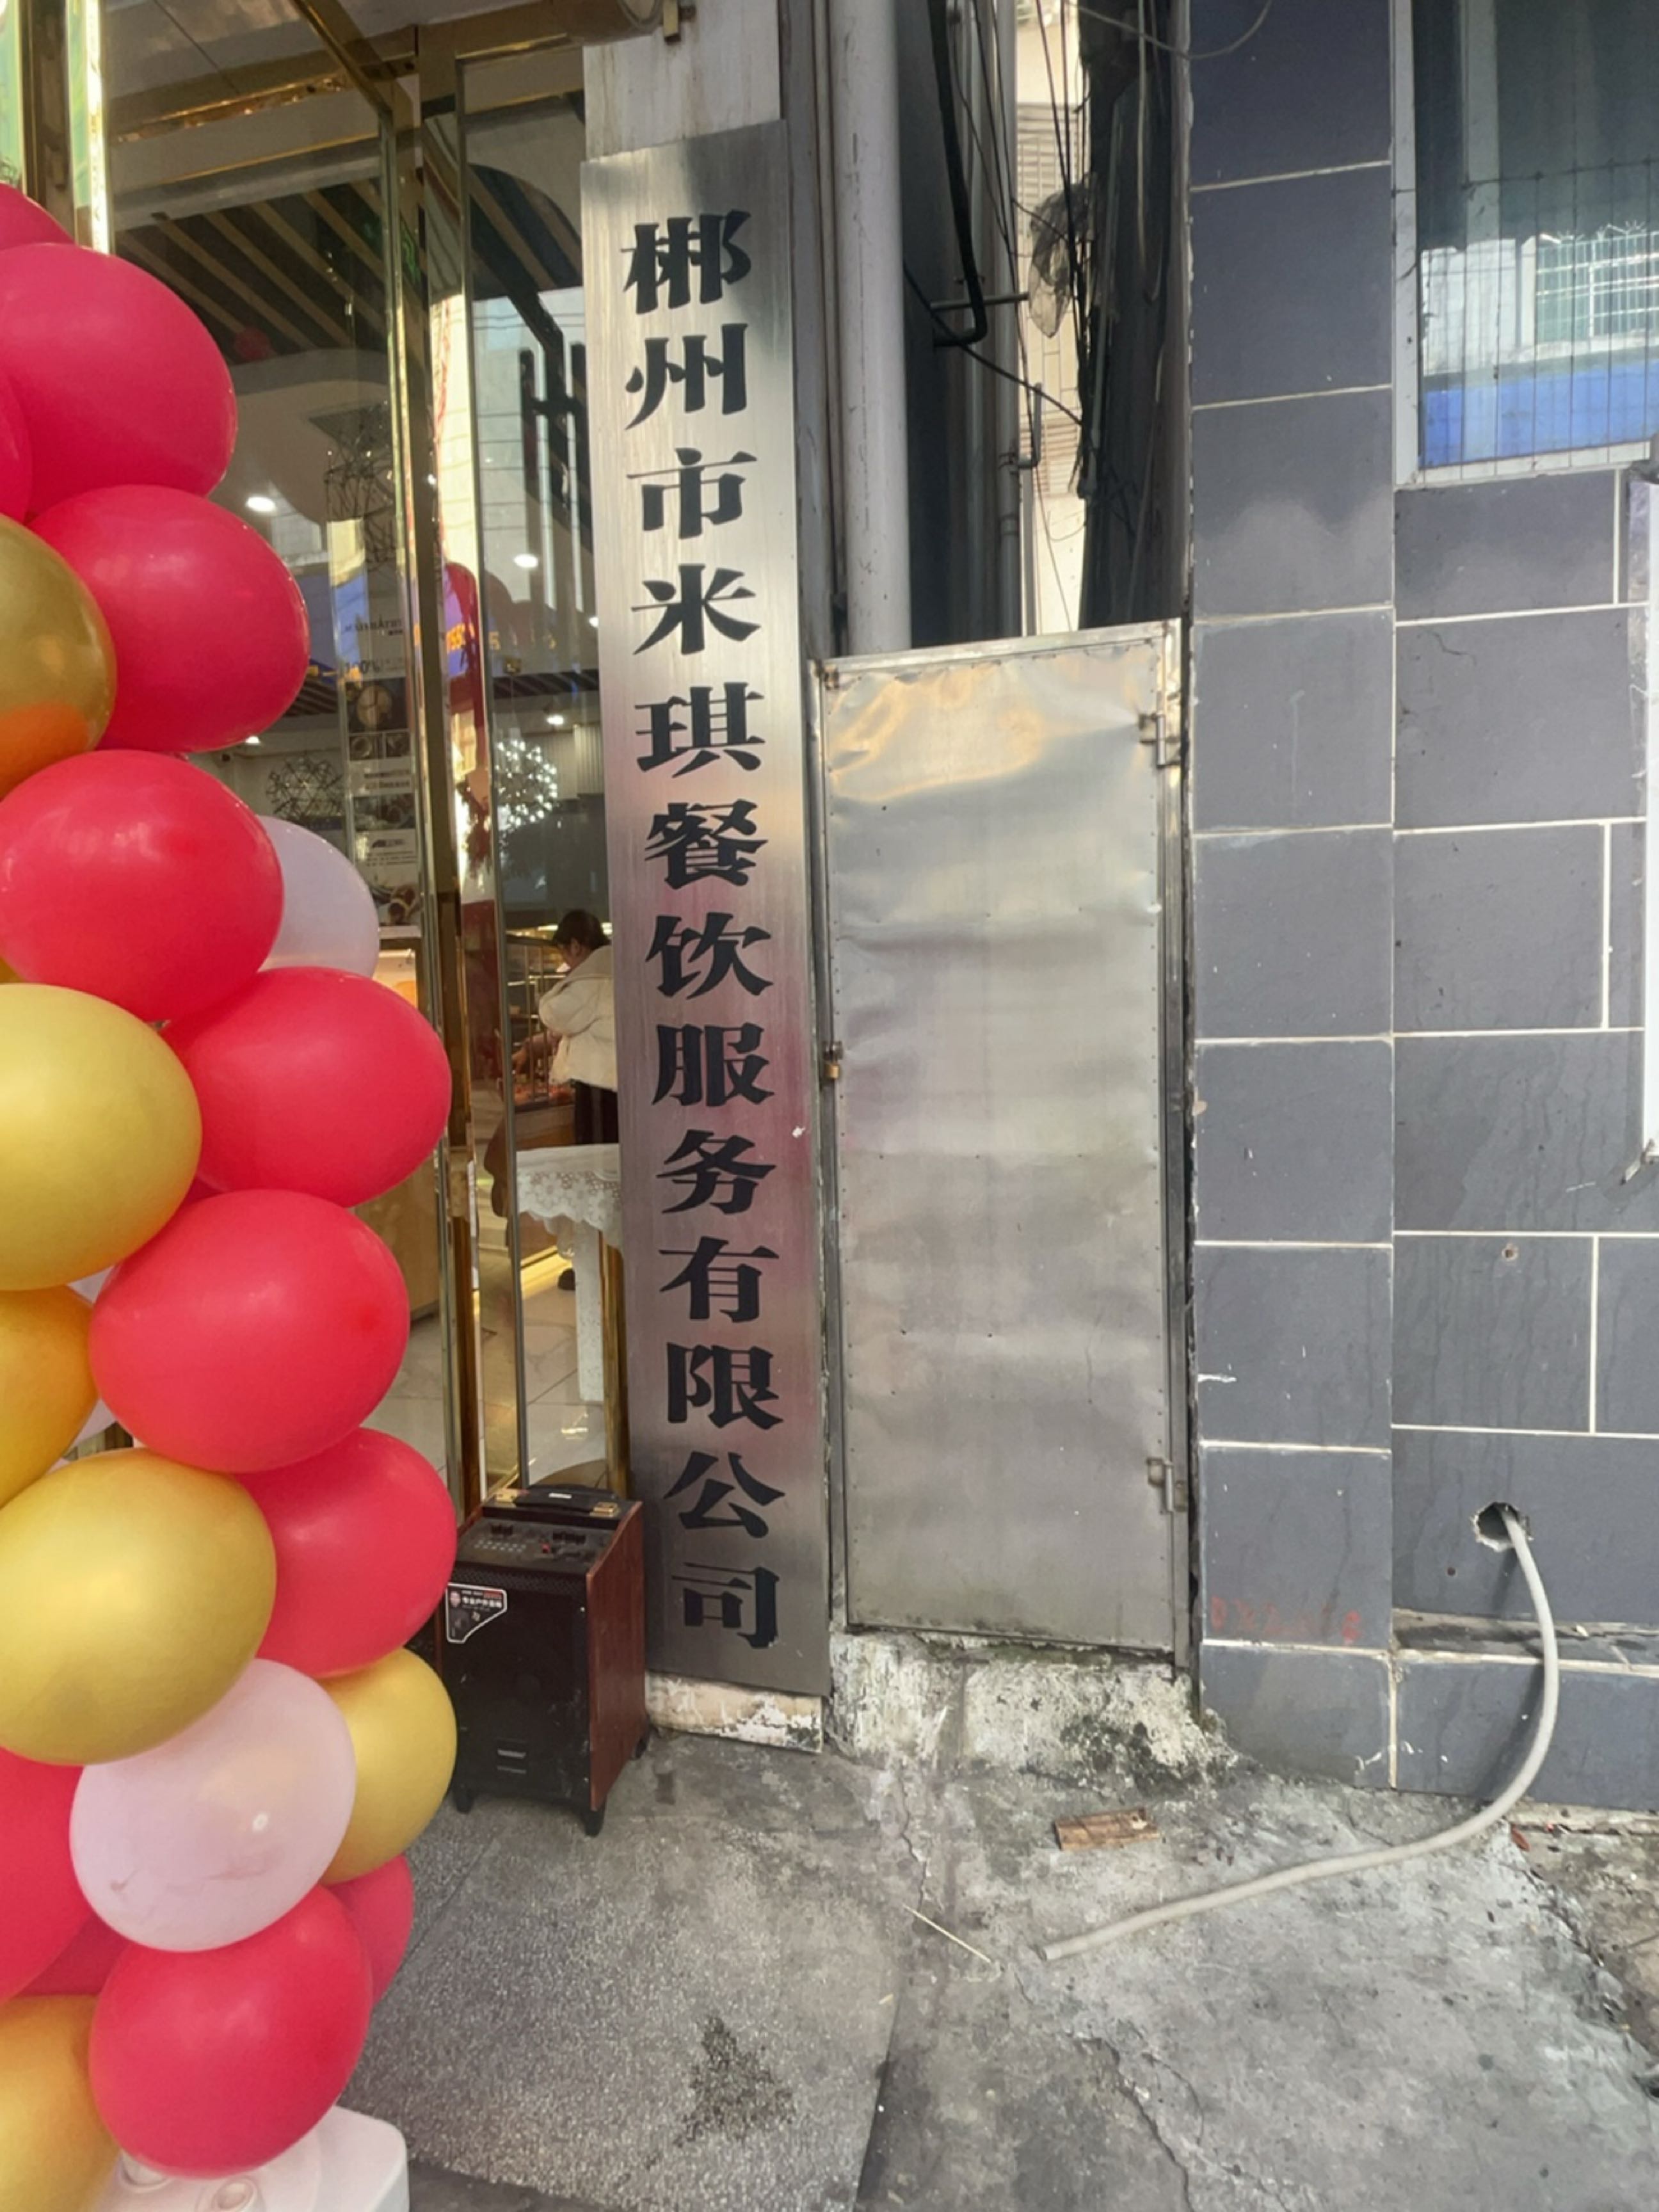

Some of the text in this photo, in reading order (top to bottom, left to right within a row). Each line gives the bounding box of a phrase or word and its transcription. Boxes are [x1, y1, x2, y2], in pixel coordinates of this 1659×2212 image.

[621, 210, 785, 1648] 郴州市米琪餐饮服务有限公司
